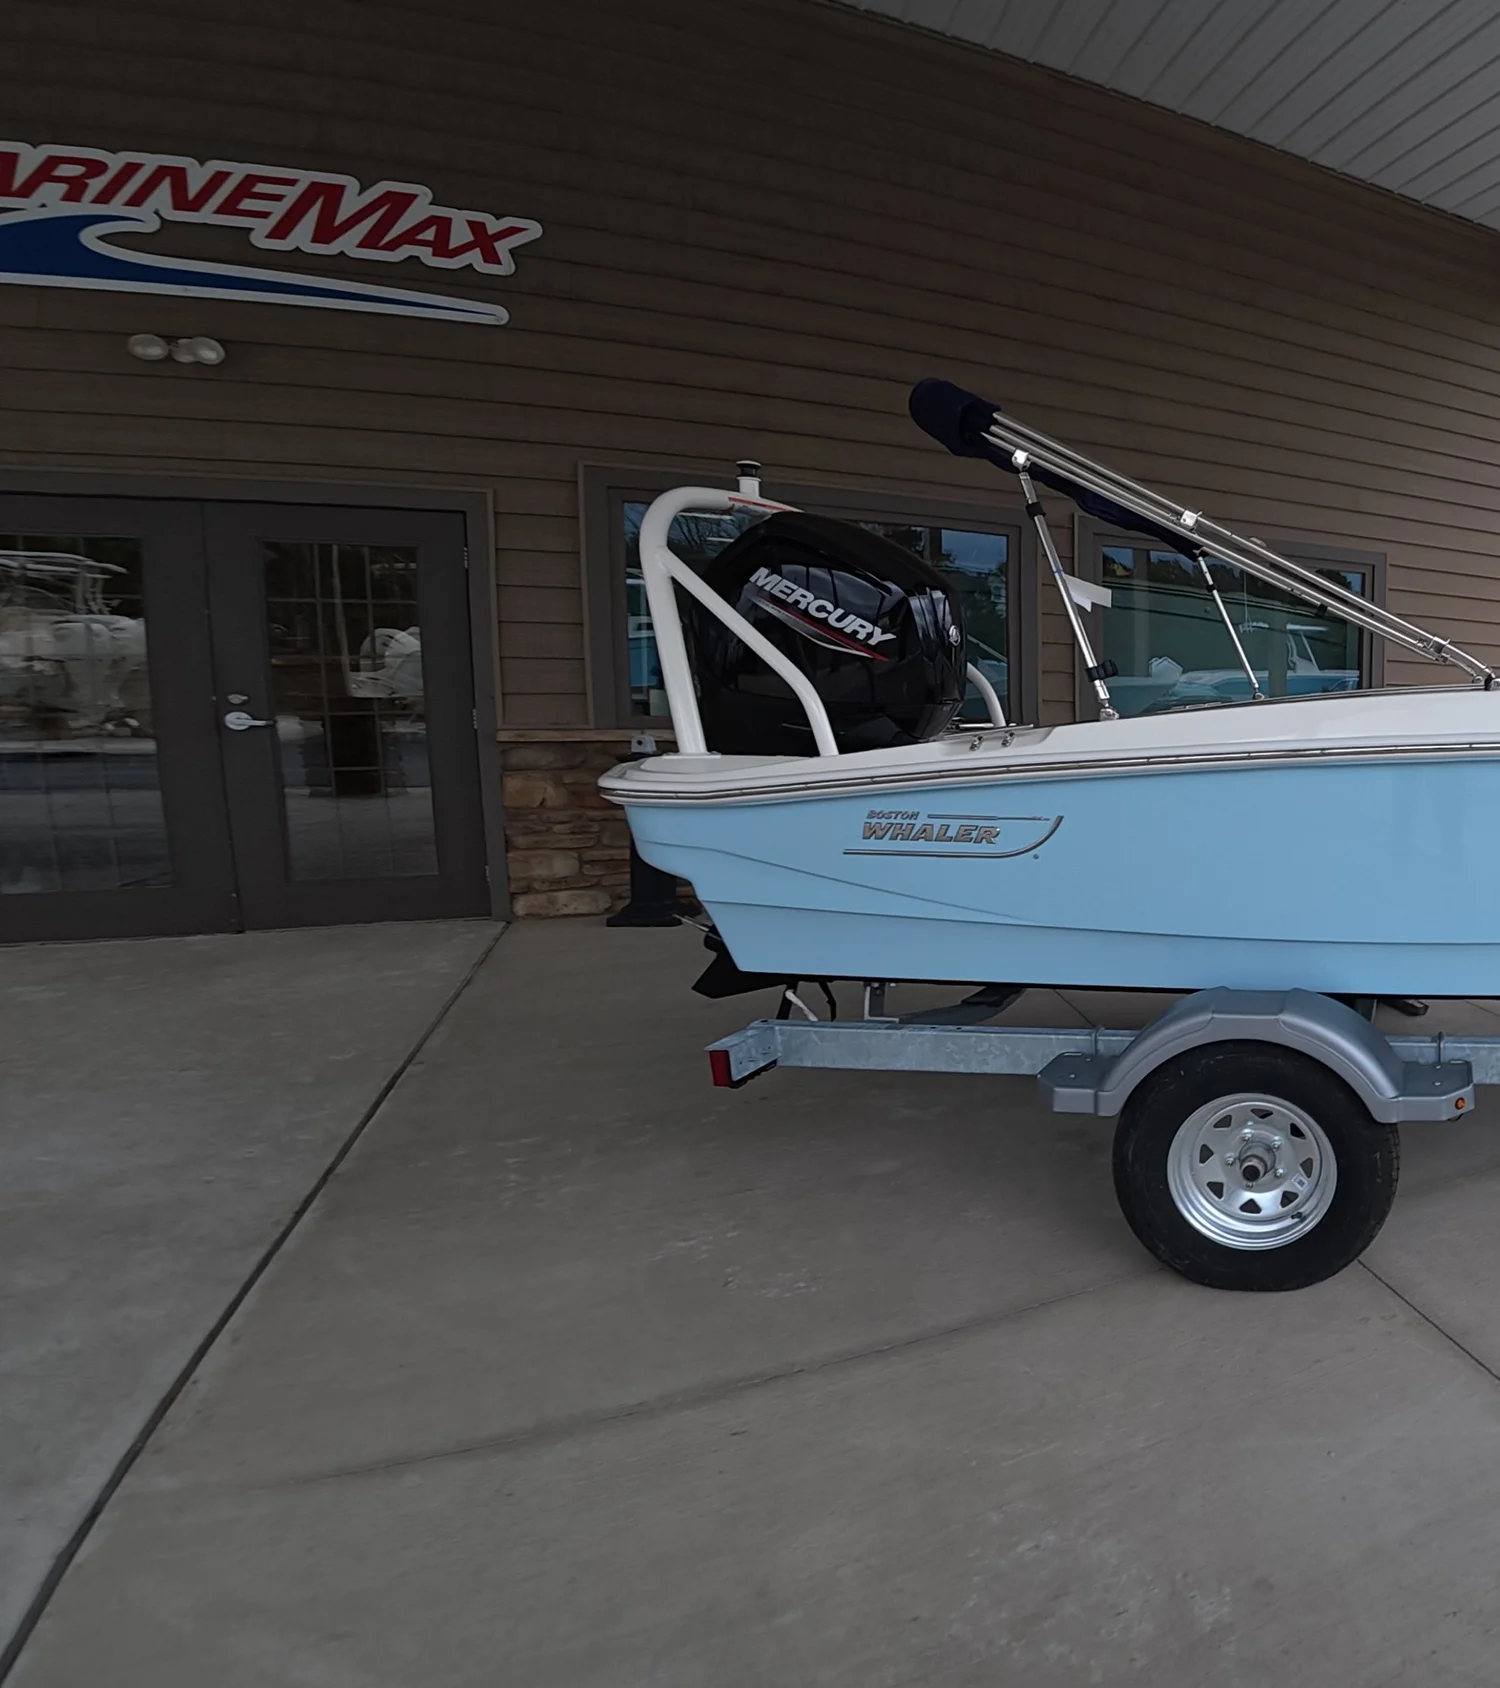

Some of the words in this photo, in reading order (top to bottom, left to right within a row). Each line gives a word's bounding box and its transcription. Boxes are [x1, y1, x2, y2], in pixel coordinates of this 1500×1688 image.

[749, 566, 897, 646] MERCURY
[866, 809, 920, 821] BOSTON
[862, 821, 1001, 844] WHALER
